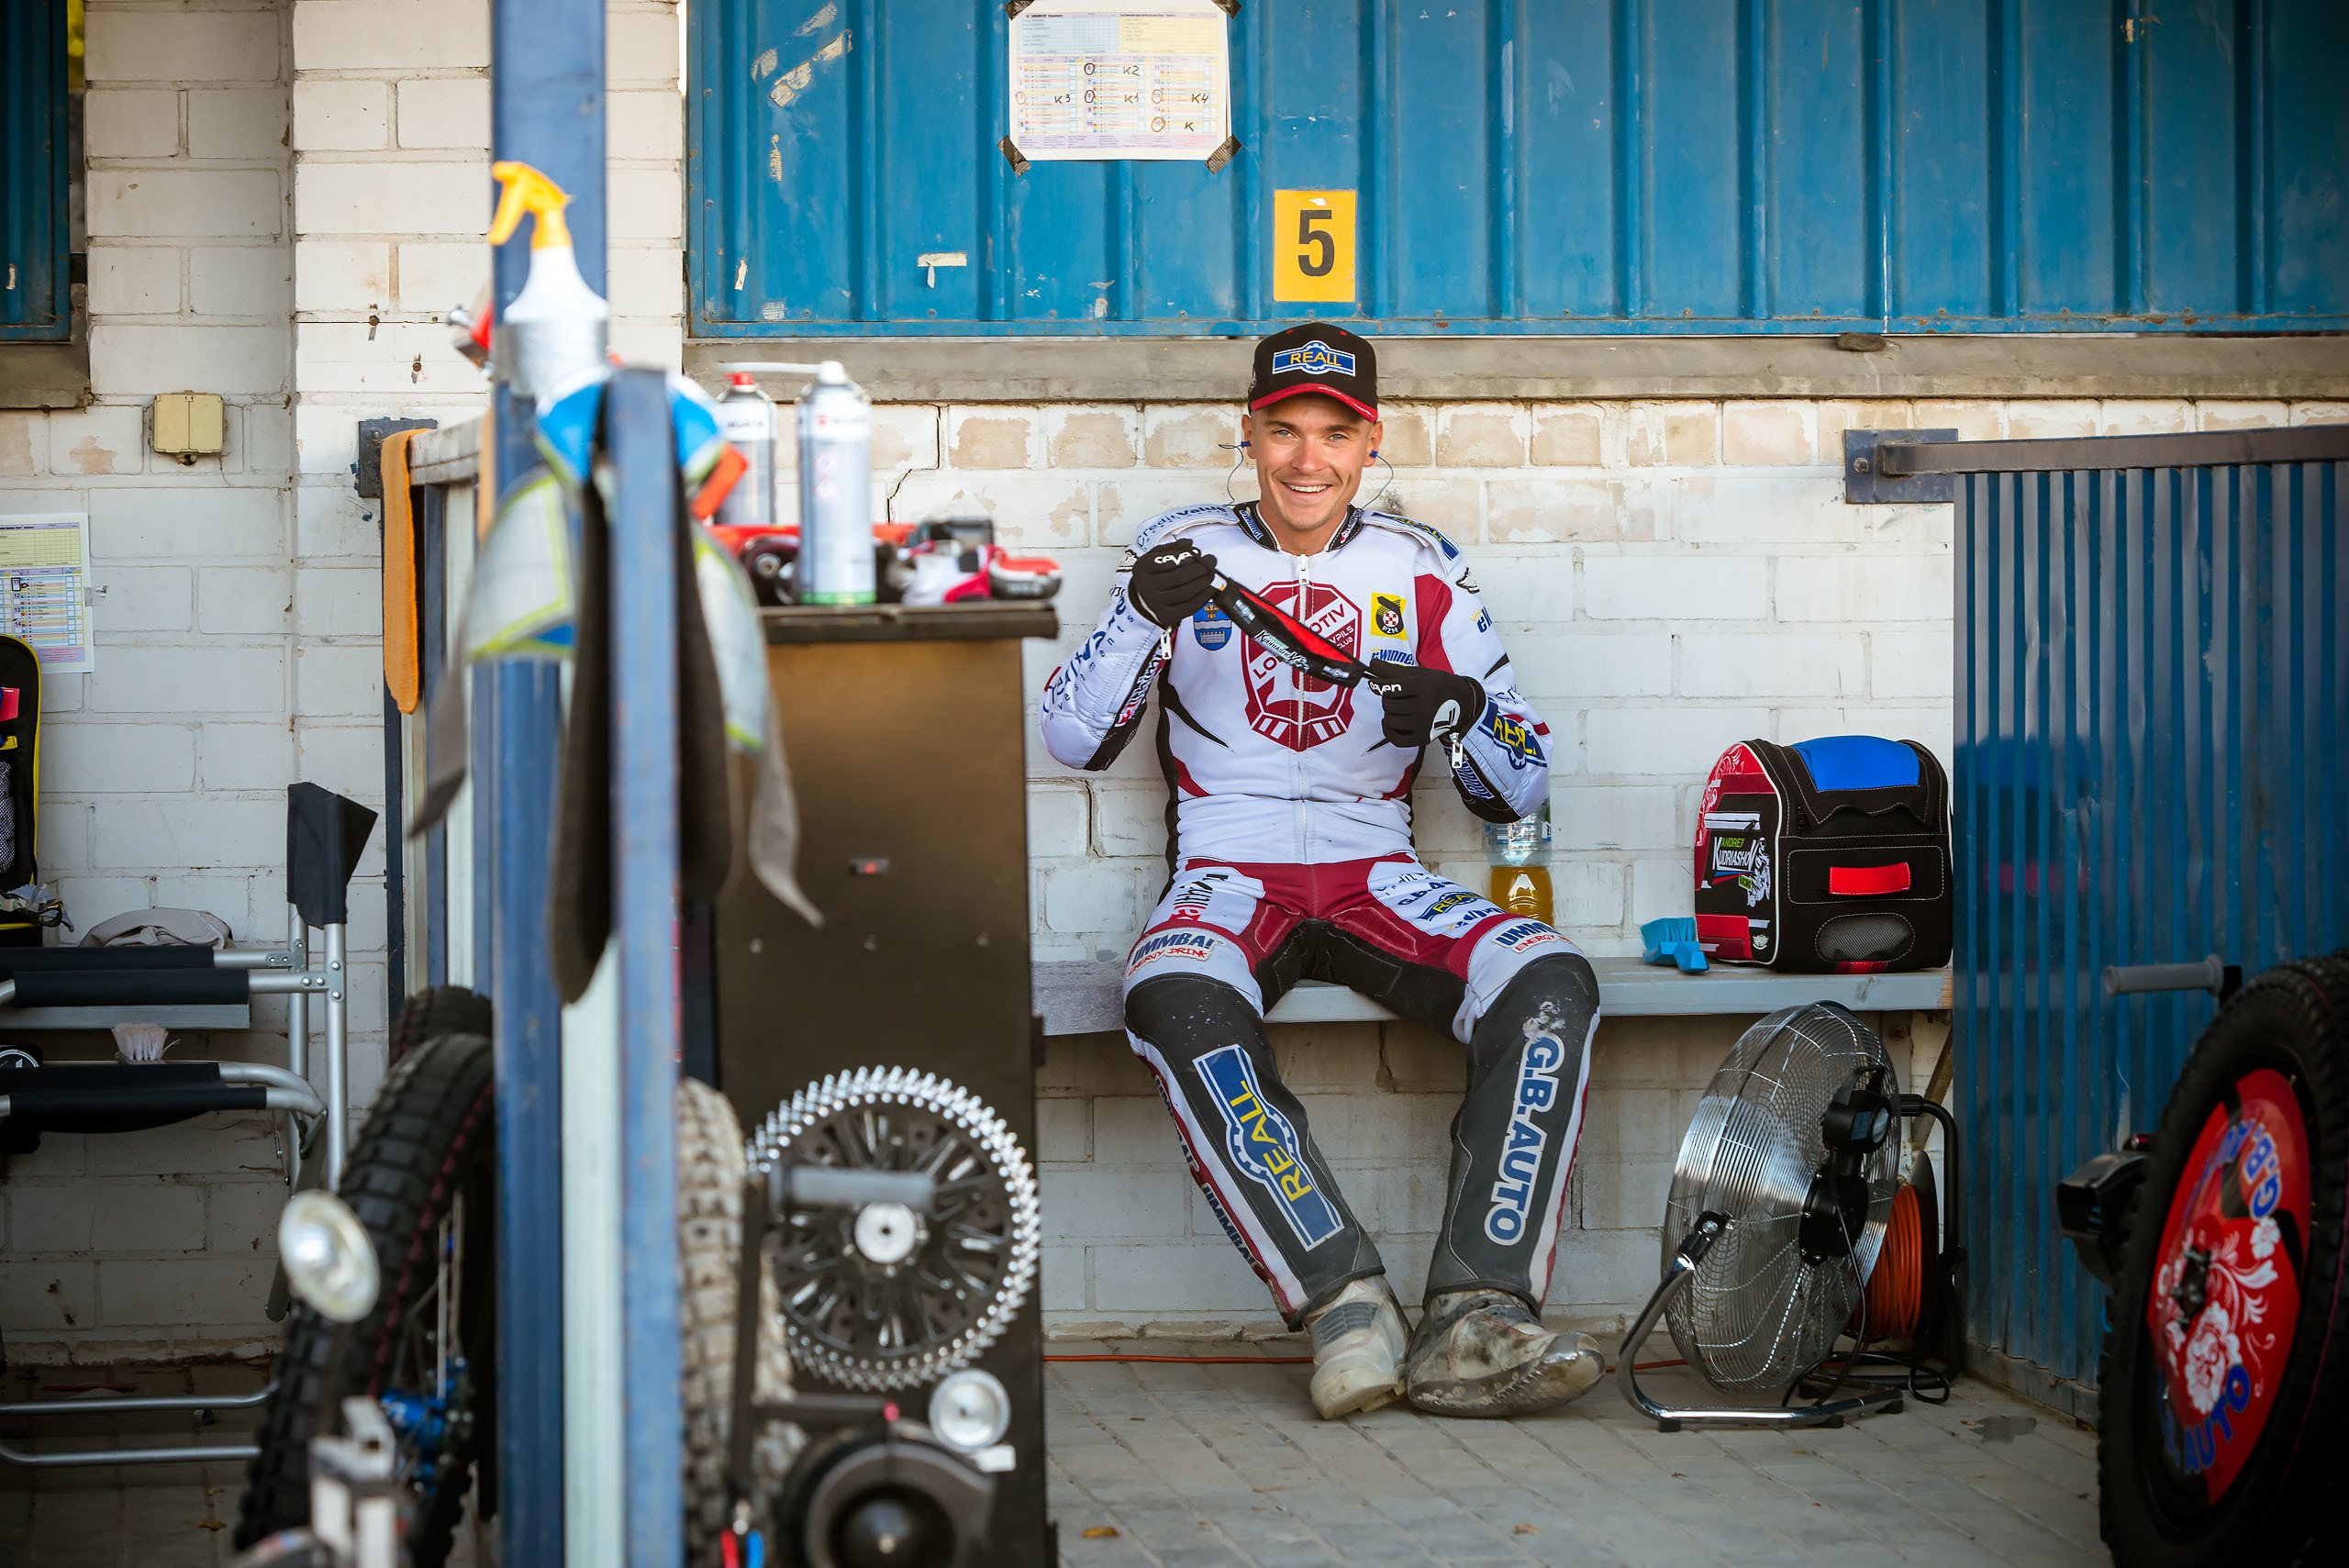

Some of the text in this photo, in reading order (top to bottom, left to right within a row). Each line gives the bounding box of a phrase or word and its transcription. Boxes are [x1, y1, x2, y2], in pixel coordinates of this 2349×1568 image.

[1123, 65, 1140, 76] K2
[1124, 93, 1139, 104] K1
[1191, 94, 1209, 105] K4
[1297, 209, 1335, 276] 5
[1290, 350, 1341, 367] REALL
[1381, 625, 1399, 634] PZM
[1167, 947, 1208, 958] DRINK
[1230, 1080, 1312, 1202] REALL
[1488, 1036, 1560, 1242] G.B.AUTO
